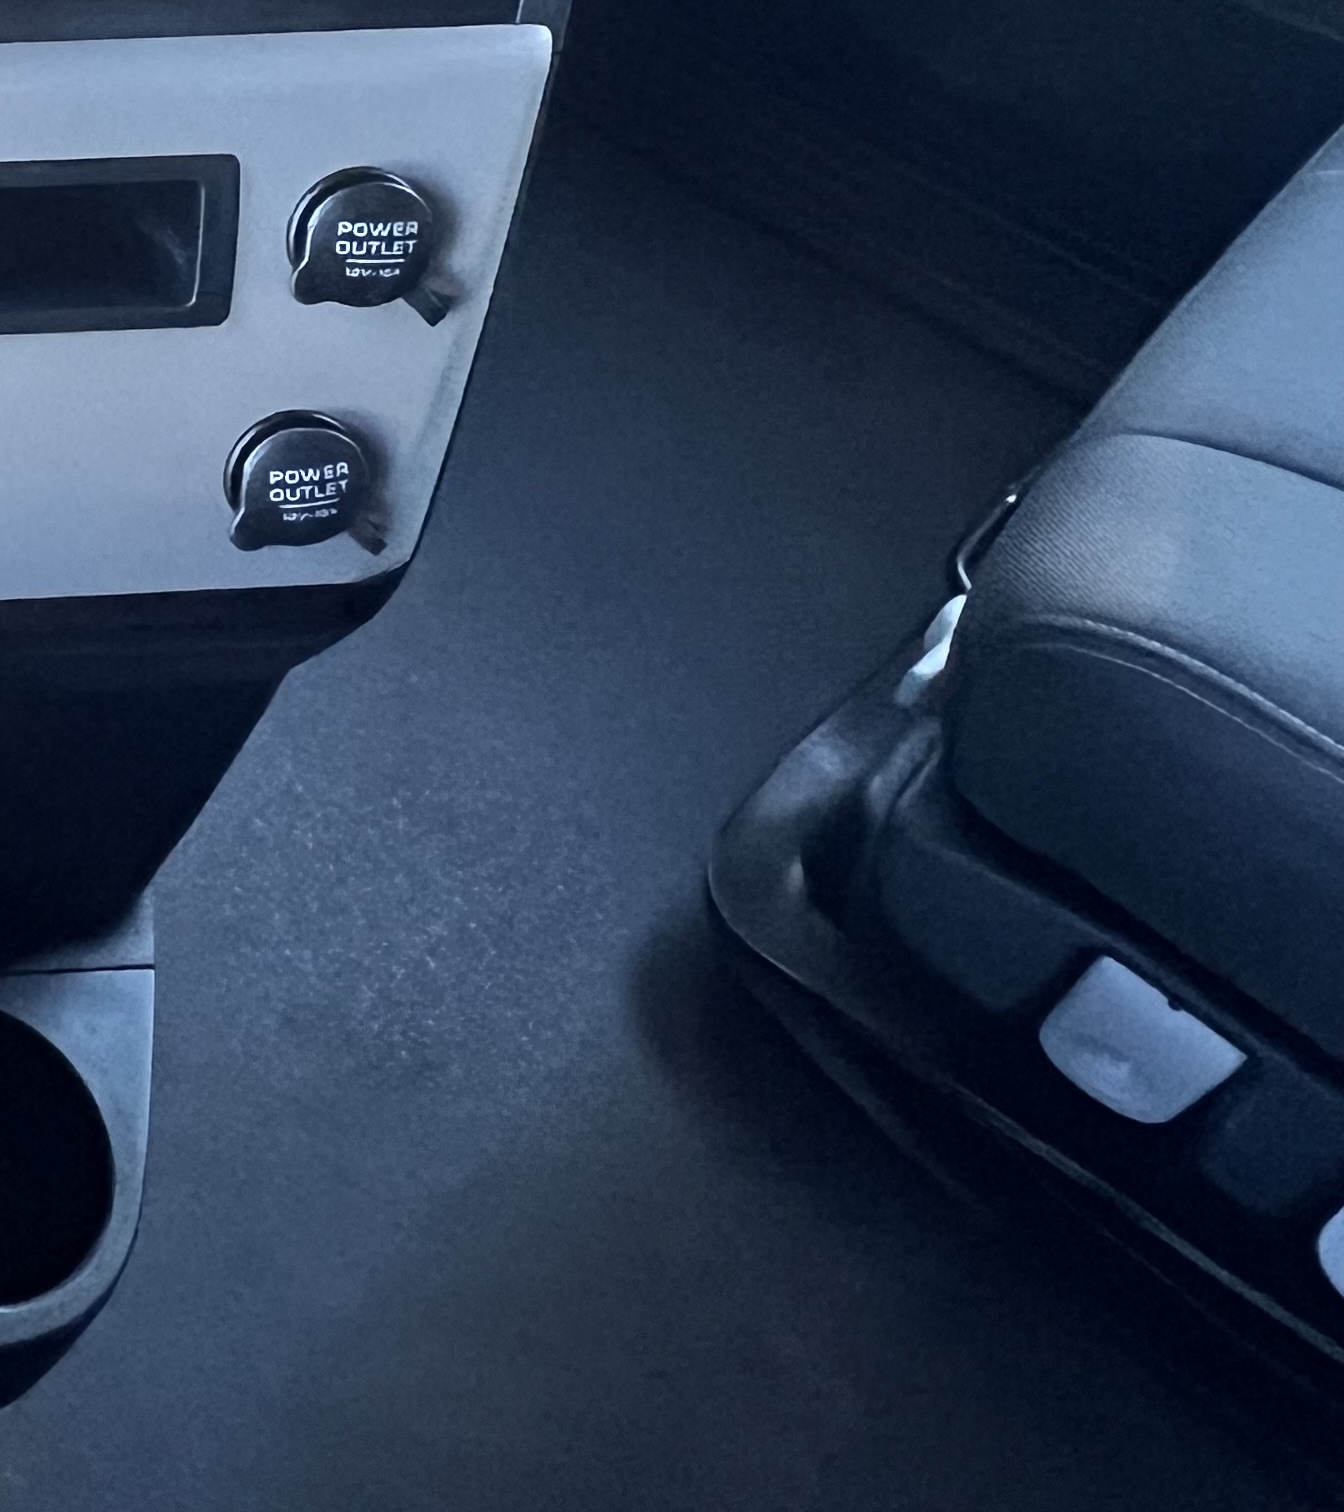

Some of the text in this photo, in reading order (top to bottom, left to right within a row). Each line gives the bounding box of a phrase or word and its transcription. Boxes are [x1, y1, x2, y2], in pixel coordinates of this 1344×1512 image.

[337, 221, 419, 237] POWER
[335, 239, 418, 255] OUTLET
[269, 461, 349, 485] POWER
[269, 479, 349, 502] OUTLET
